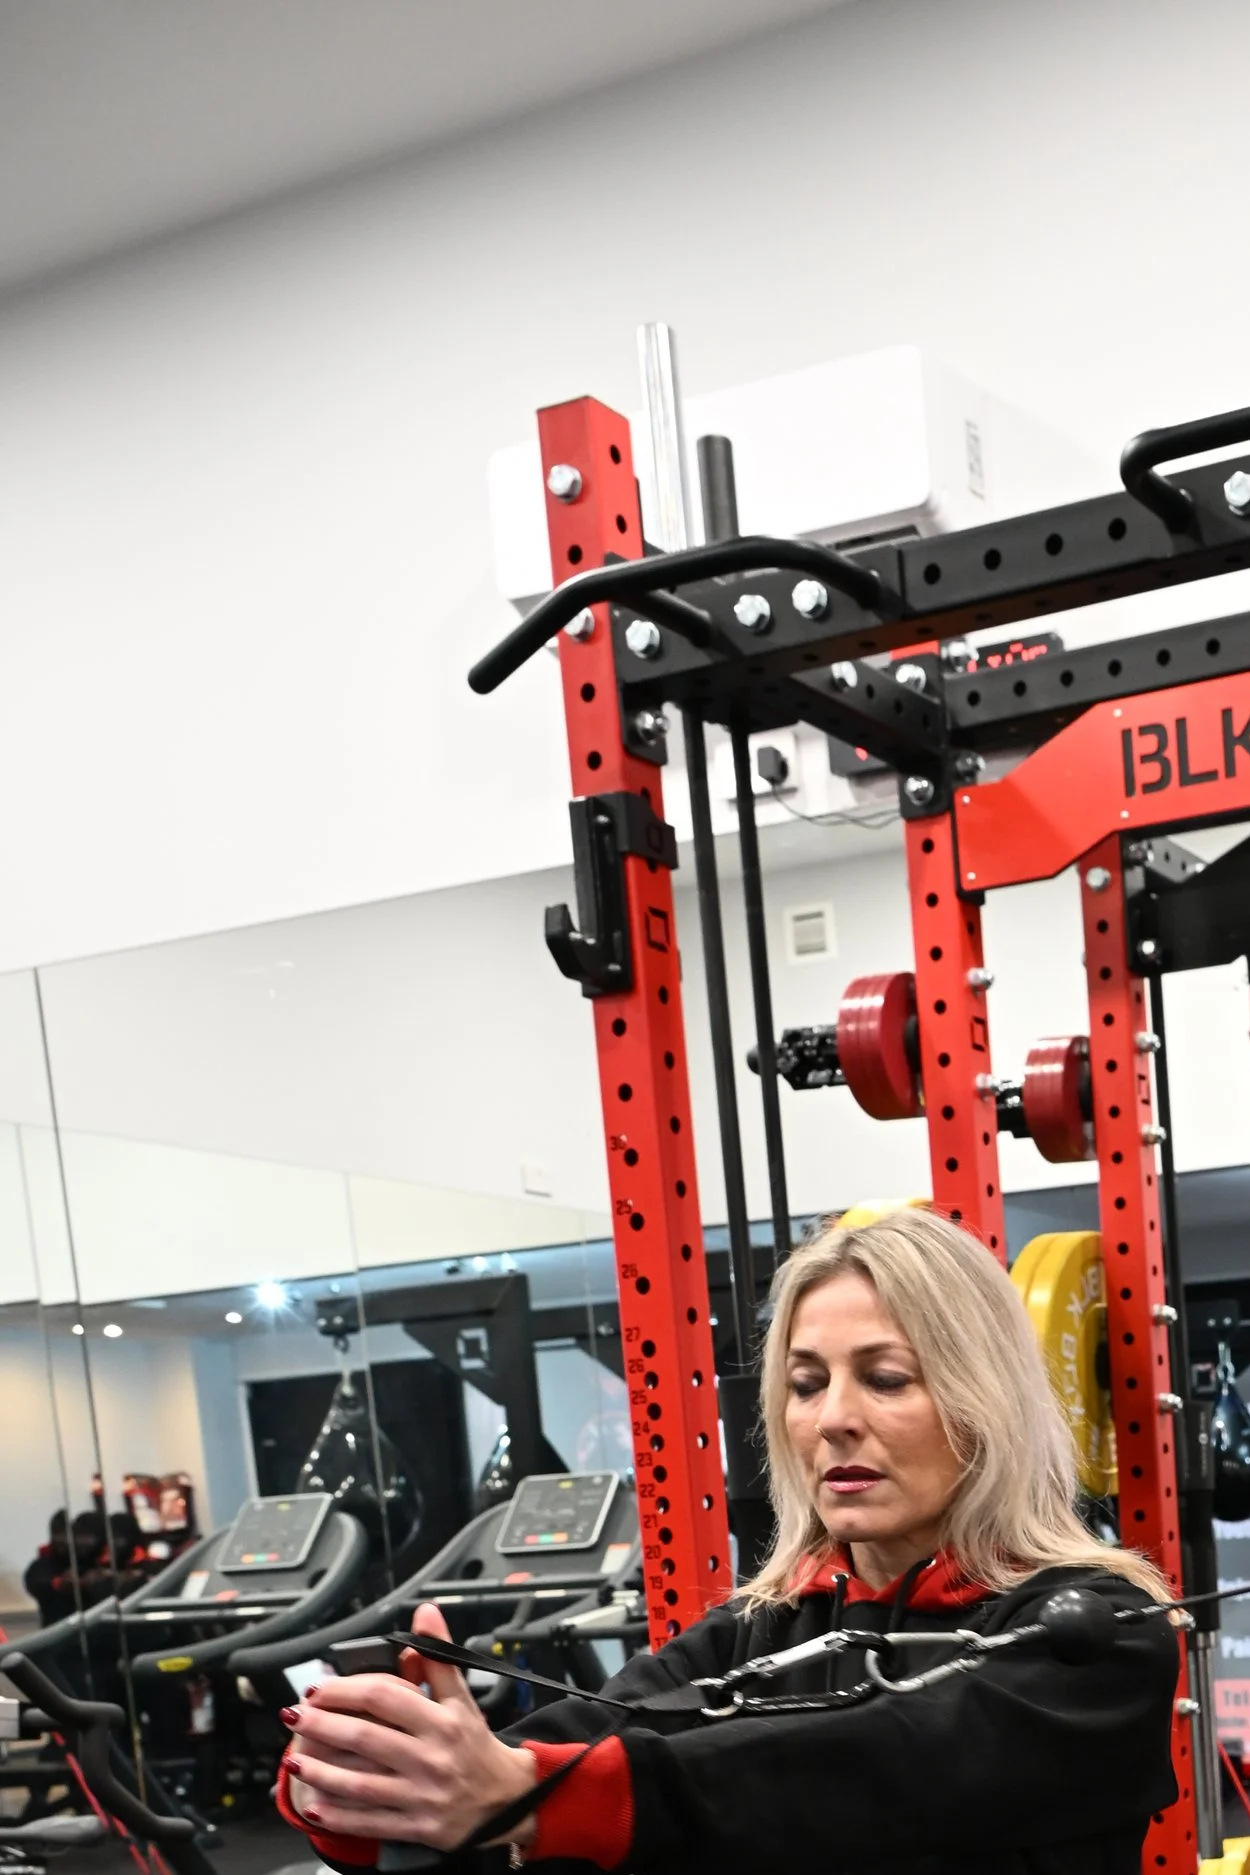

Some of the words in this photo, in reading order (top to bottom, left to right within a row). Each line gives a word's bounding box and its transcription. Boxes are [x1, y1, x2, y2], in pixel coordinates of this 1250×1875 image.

[625, 1326, 640, 1342] 27
[628, 1358, 645, 1374] 26
[631, 1390, 647, 1405] 25
[633, 1421, 650, 1436] 24
[636, 1452, 653, 1468] 23
[639, 1483, 656, 1498] 22
[643, 1514, 658, 1529] 21
[645, 1545, 661, 1560] 20
[648, 1575, 663, 1590] 19
[651, 1606, 666, 1620] 18
